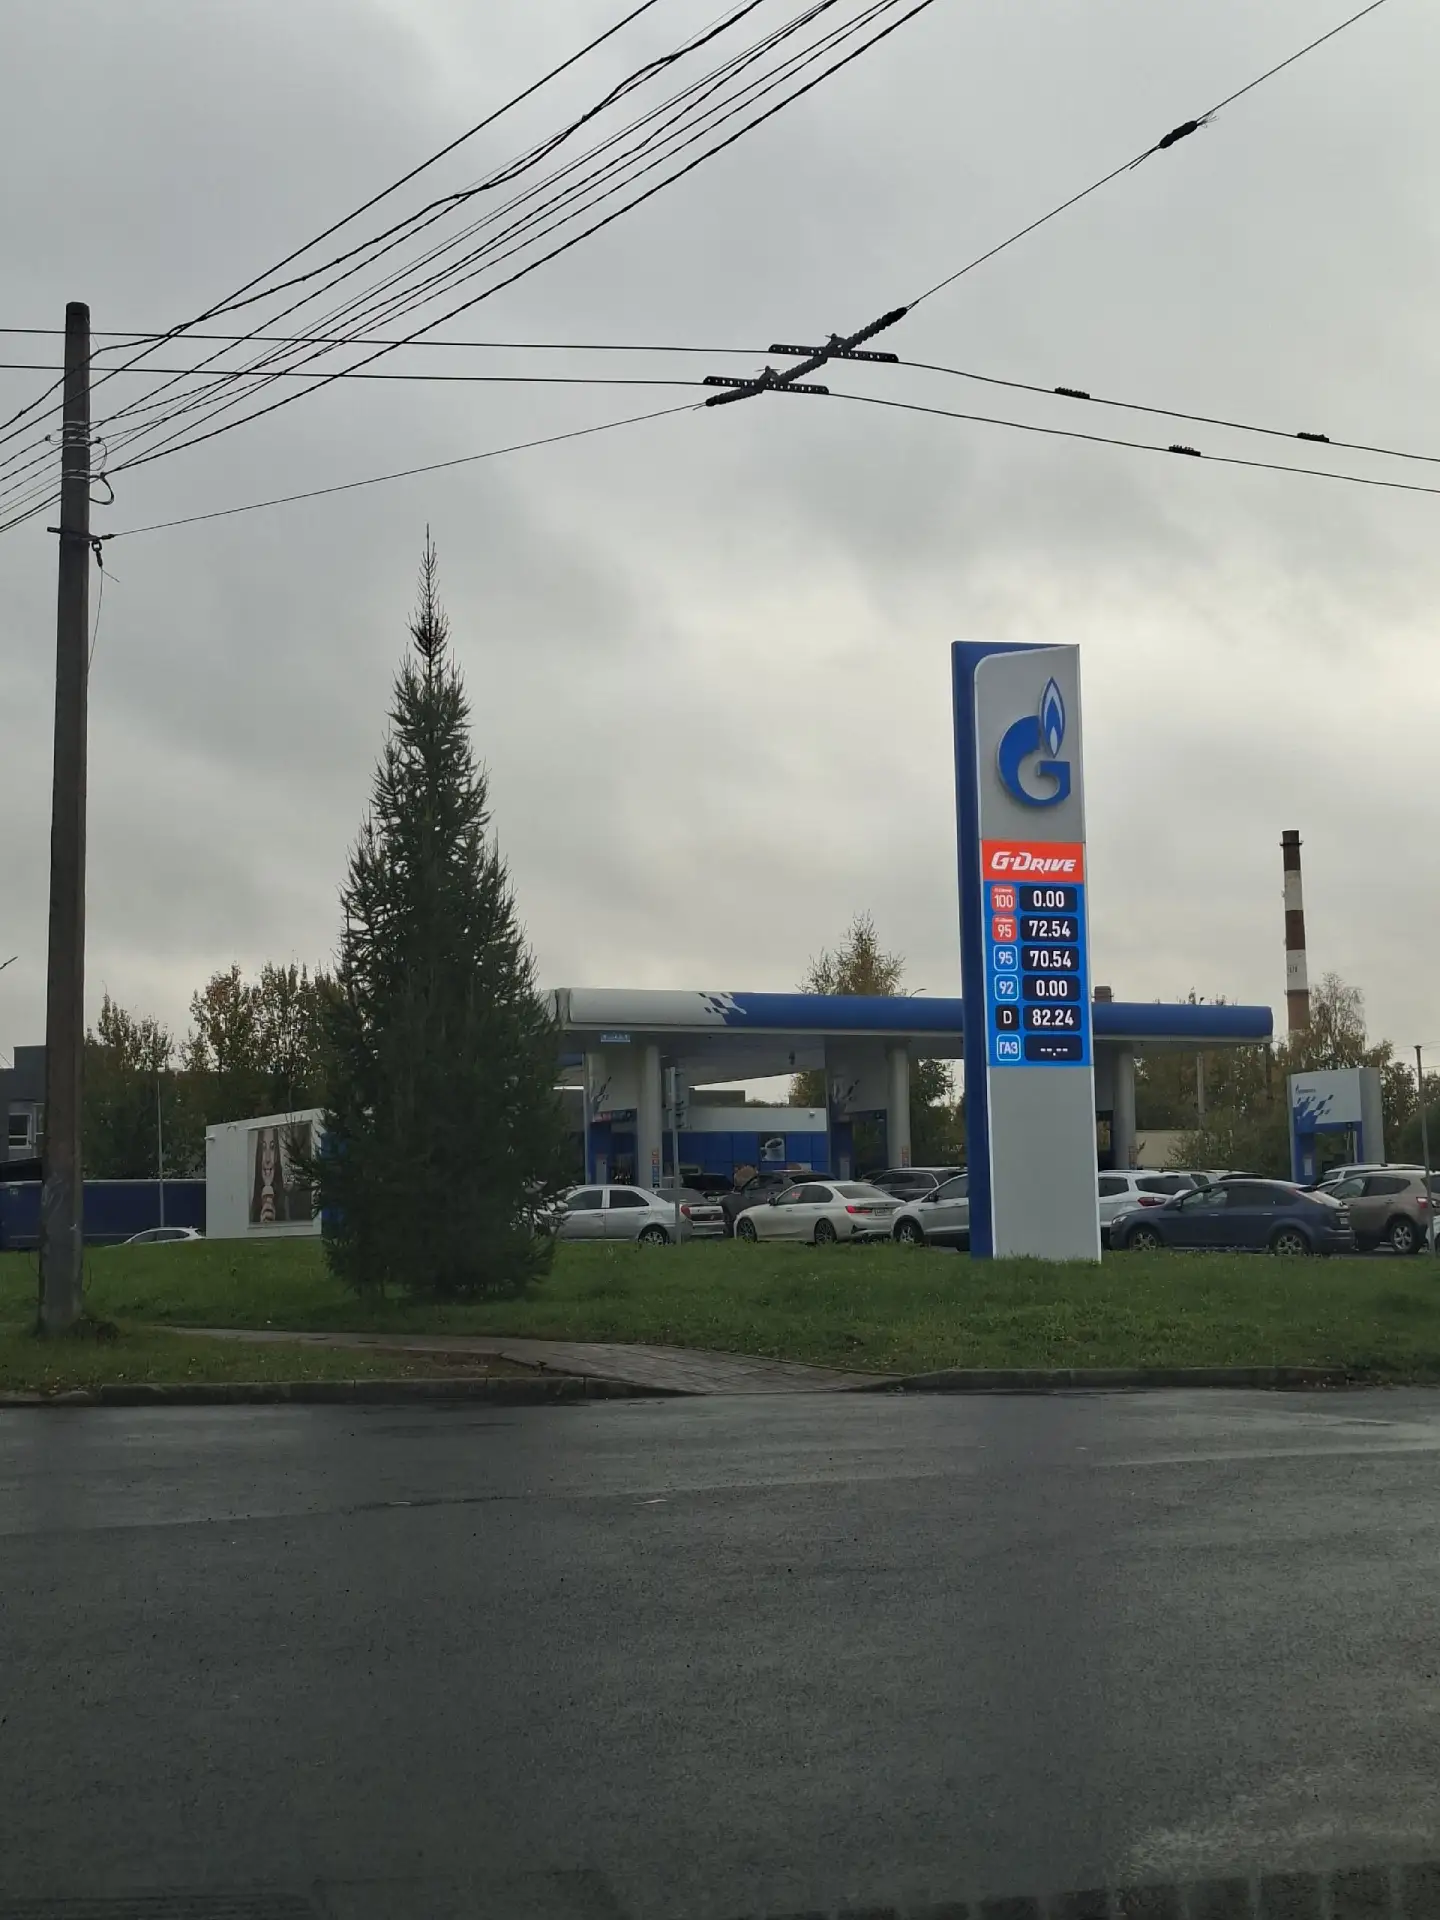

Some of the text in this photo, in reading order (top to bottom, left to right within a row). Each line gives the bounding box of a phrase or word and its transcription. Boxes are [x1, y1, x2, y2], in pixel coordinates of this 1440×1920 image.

[995, 890, 1065, 908] 100 0.00
[997, 920, 1071, 938] 95 72.54
[998, 950, 1072, 968] 95 70.54
[999, 979, 1068, 997] 92 0.00
[1003, 1008, 1074, 1026] D 82.24
[999, 1041, 1018, 1055] ГАЗ
